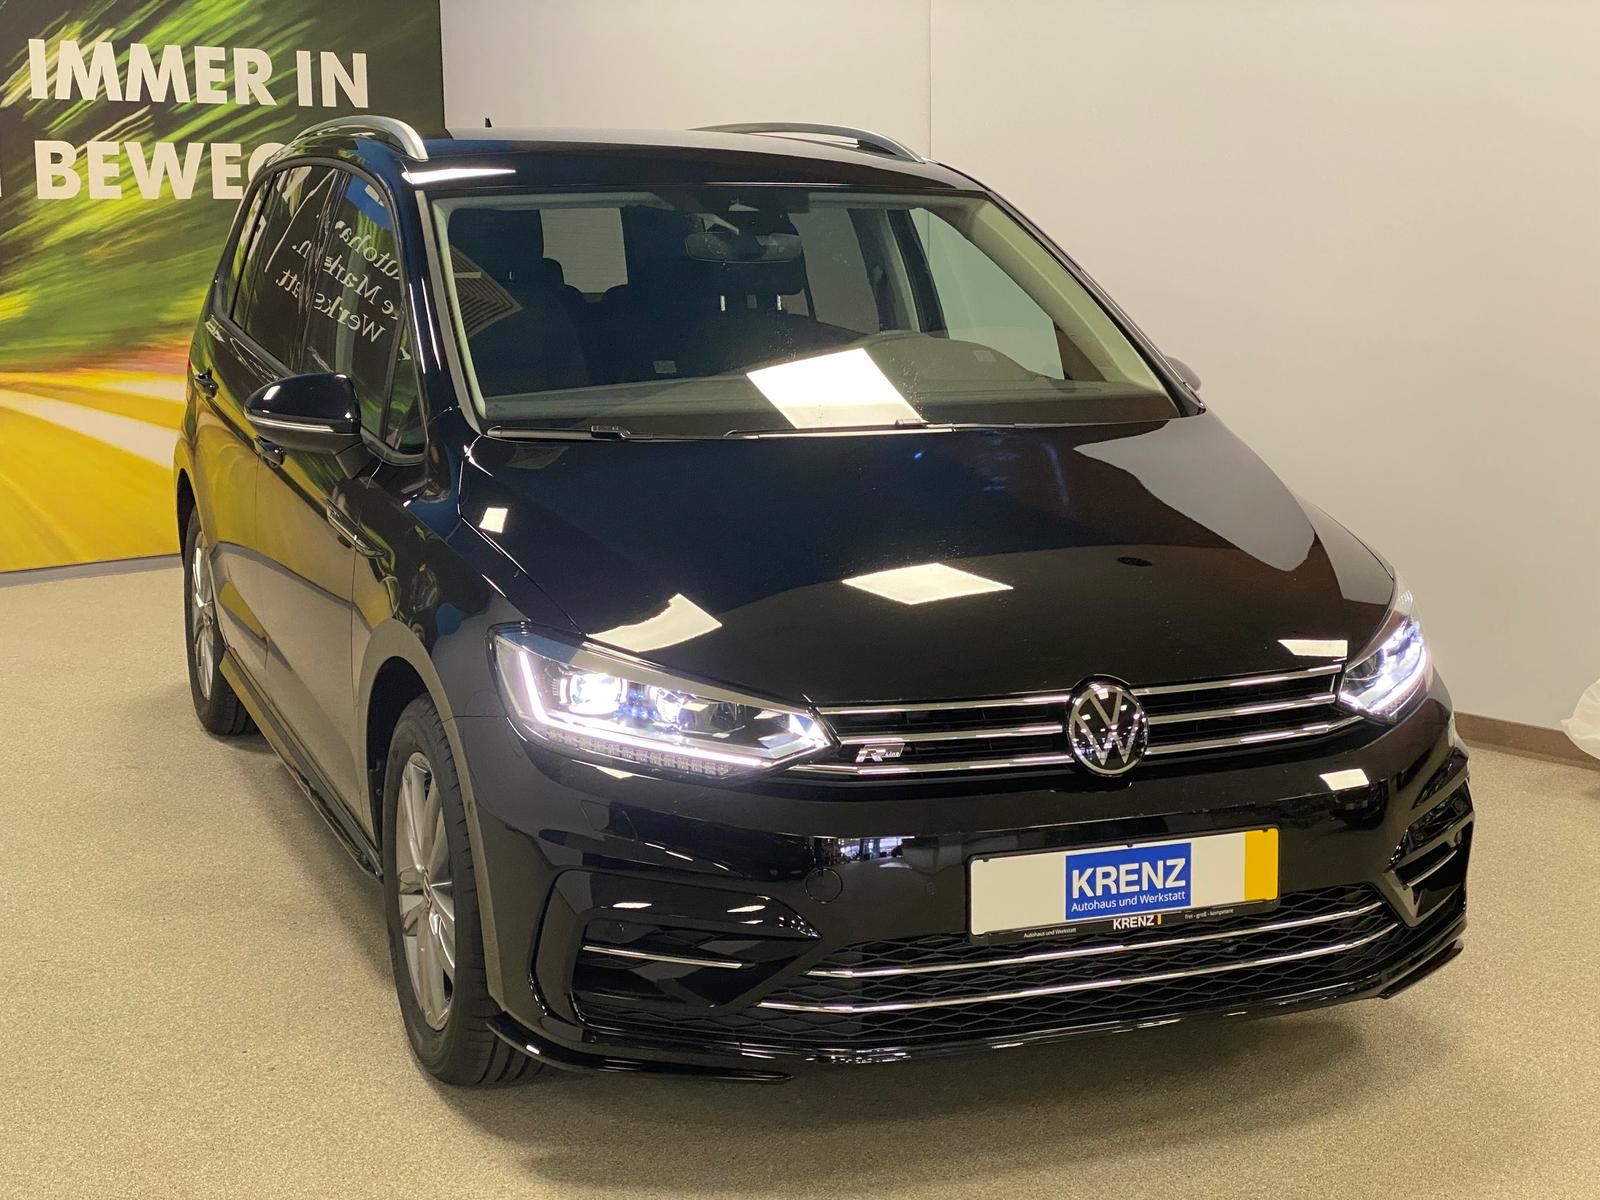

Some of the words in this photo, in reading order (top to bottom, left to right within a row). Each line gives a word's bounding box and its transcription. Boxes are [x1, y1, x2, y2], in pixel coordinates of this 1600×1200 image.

[28, 38, 277, 107] IMMER
[295, 50, 369, 109] IN
[1072, 858, 1186, 899] KRENZ
[1071, 899, 1117, 912] Autohaus
[1119, 896, 1138, 906] und
[1139, 891, 1186, 905] Werkstatt
[1113, 914, 1155, 930] KRENZ
[1023, 930, 1045, 938] Autohaus
